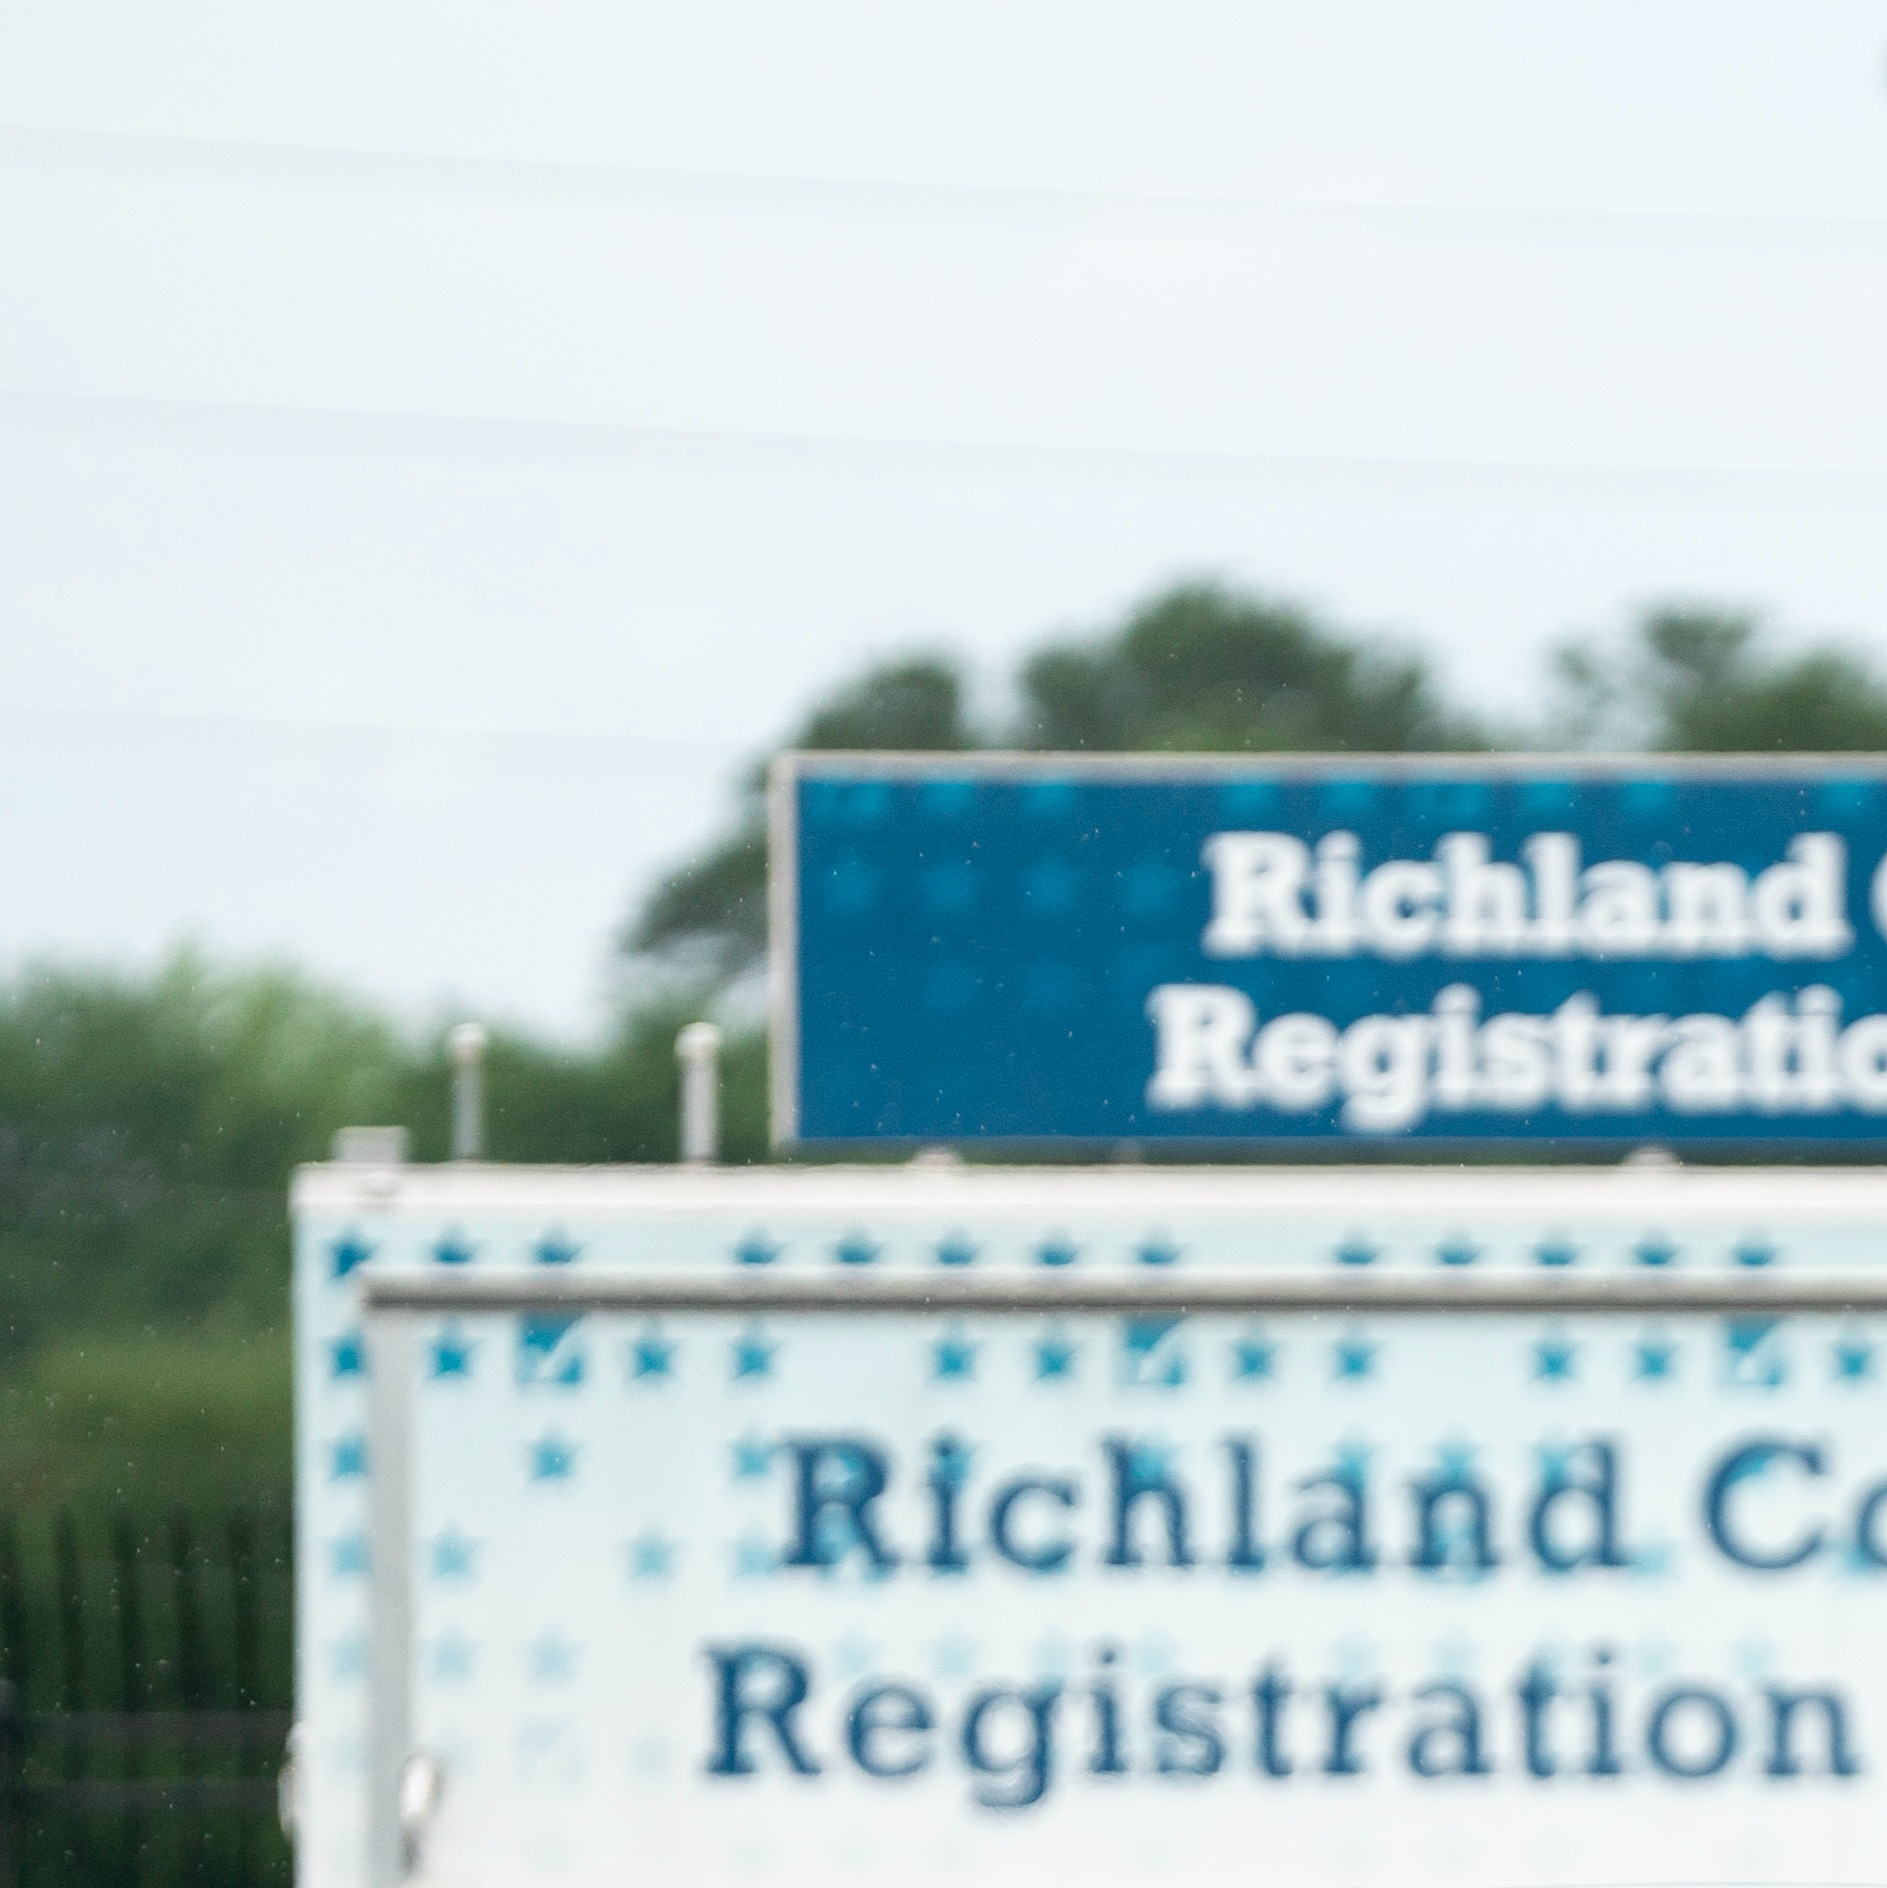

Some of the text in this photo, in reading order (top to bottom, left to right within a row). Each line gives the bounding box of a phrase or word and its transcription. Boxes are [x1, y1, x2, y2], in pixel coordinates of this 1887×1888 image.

[1203, 829, 1853, 957] Richland
[778, 1433, 1636, 1573] Richland
[702, 1642, 1863, 1812] Registration
